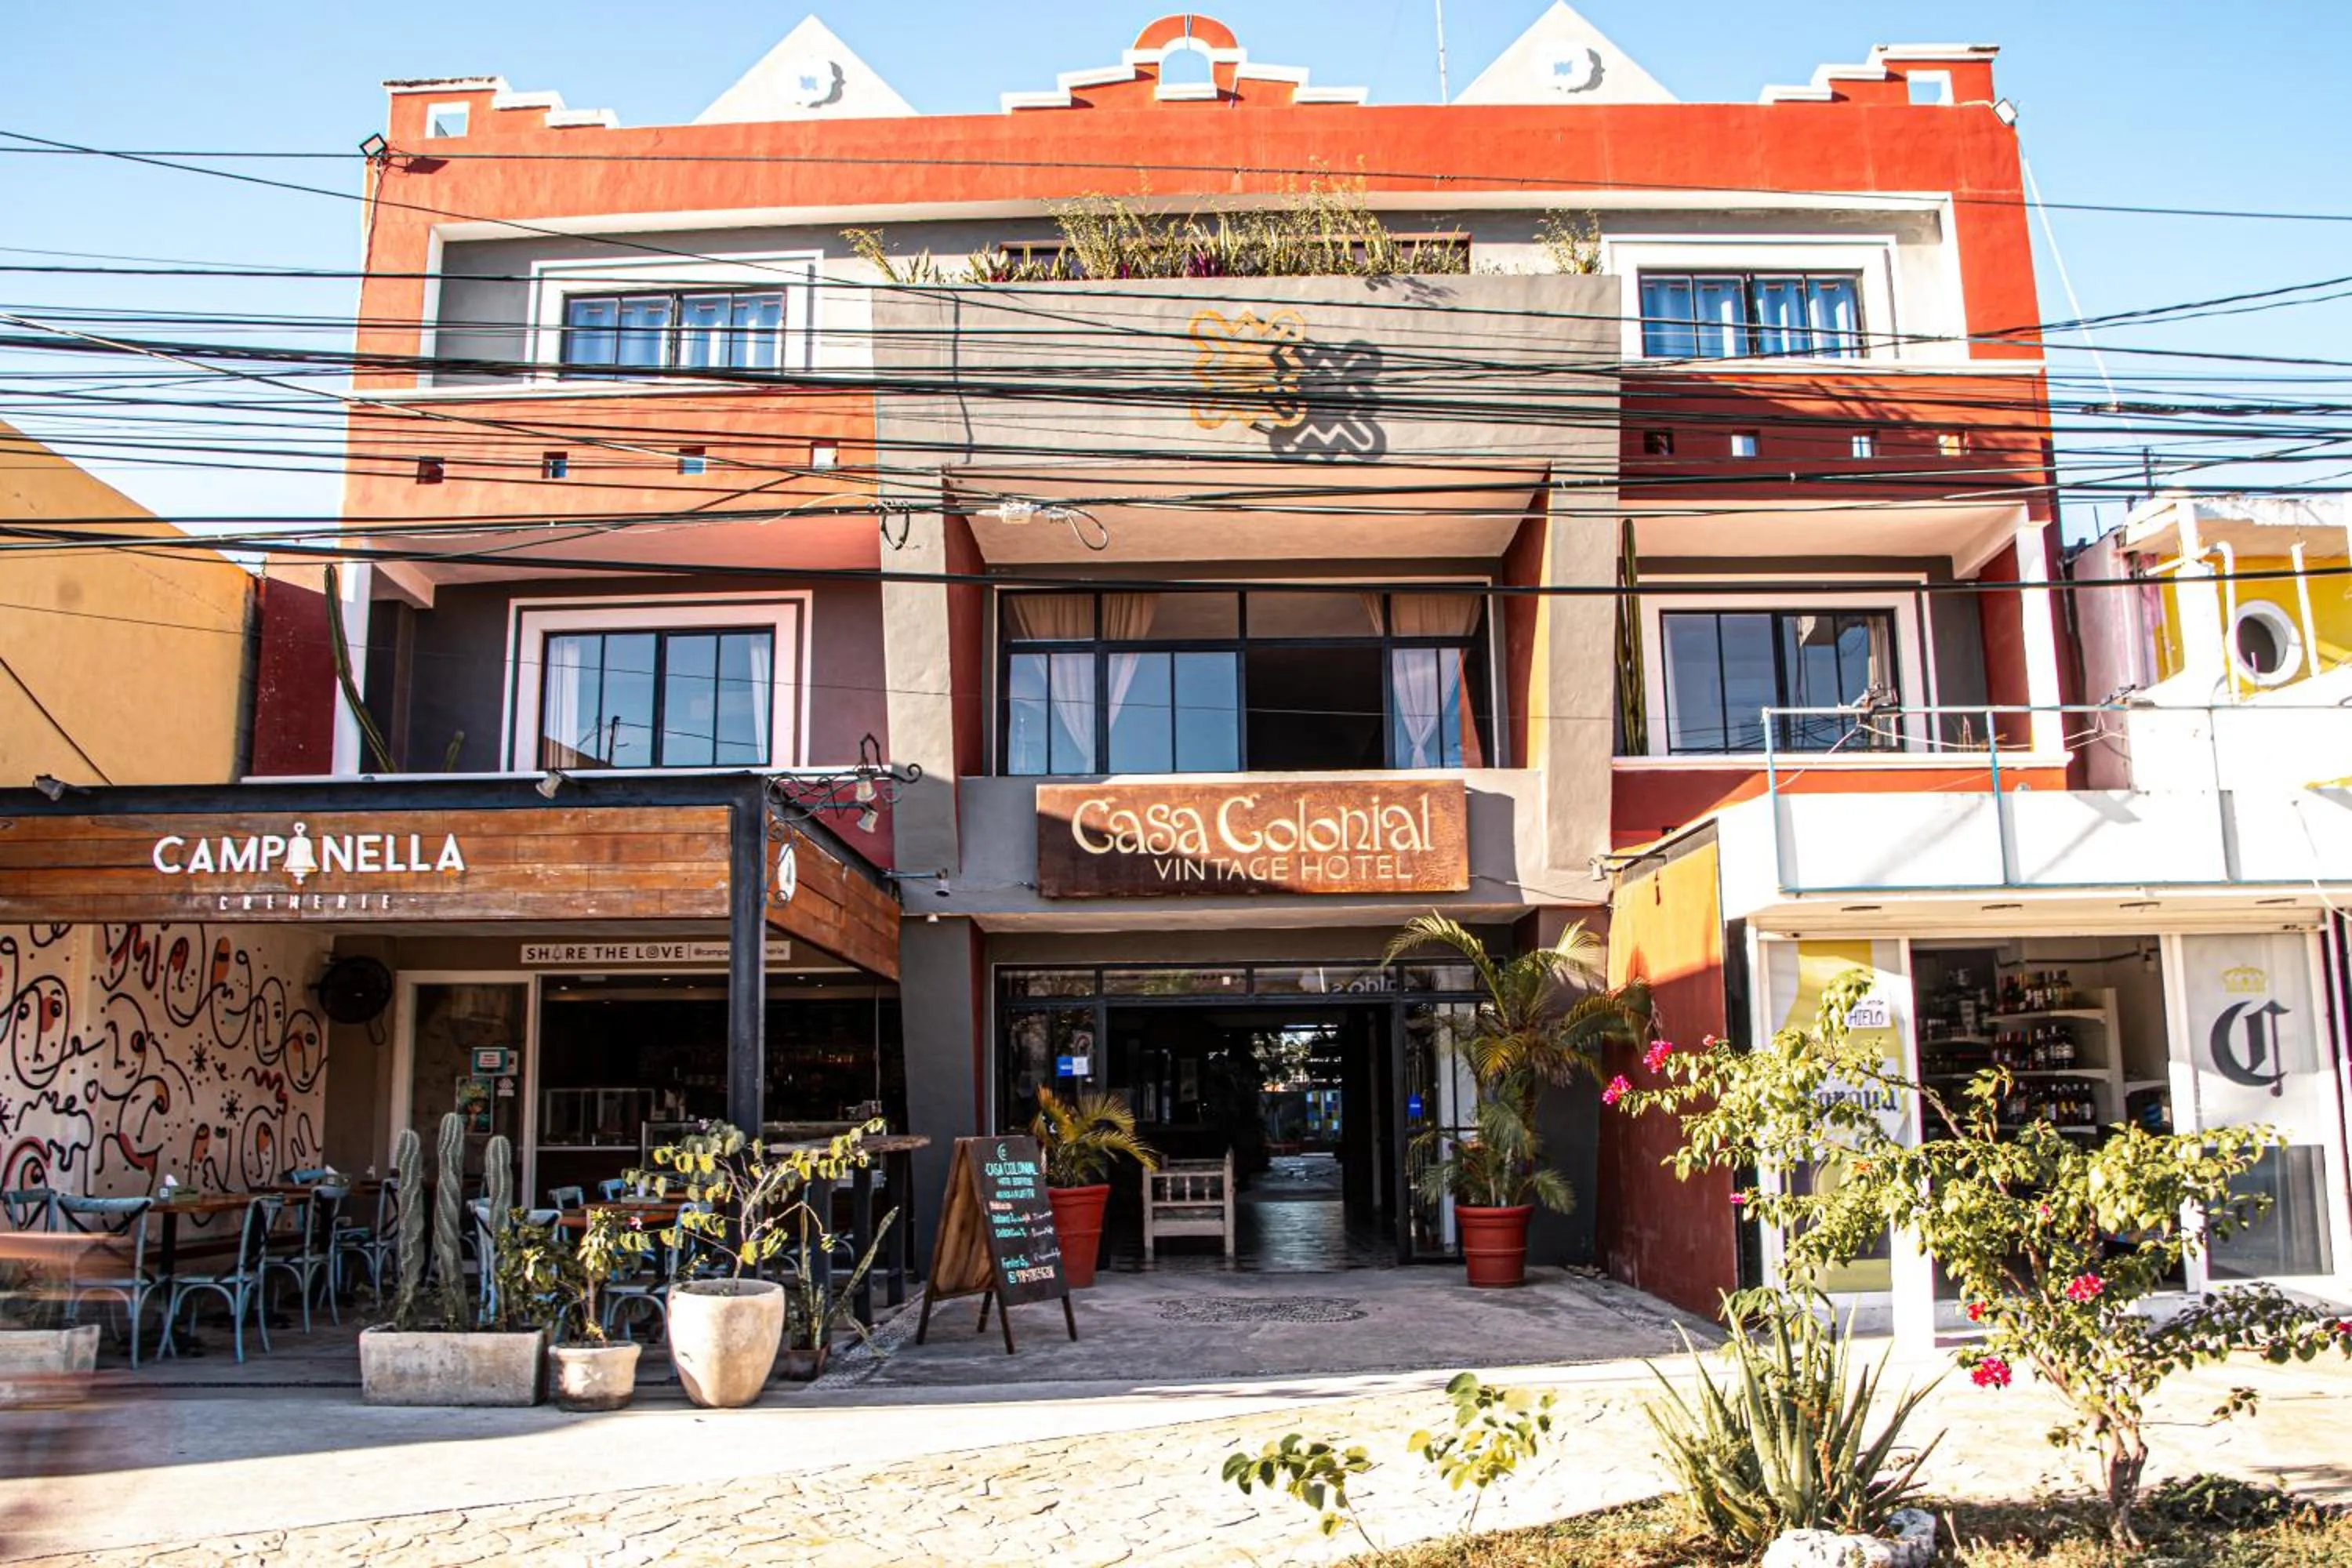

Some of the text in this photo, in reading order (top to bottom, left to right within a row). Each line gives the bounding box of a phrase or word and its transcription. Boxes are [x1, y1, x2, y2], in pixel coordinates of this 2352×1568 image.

[1072, 792, 1436, 855] Casa Colonial
[1153, 855, 1413, 882] VINTAGE HOTEL
[593, 946, 628, 959] THE
[1849, 1009, 1884, 1026] HIELO
